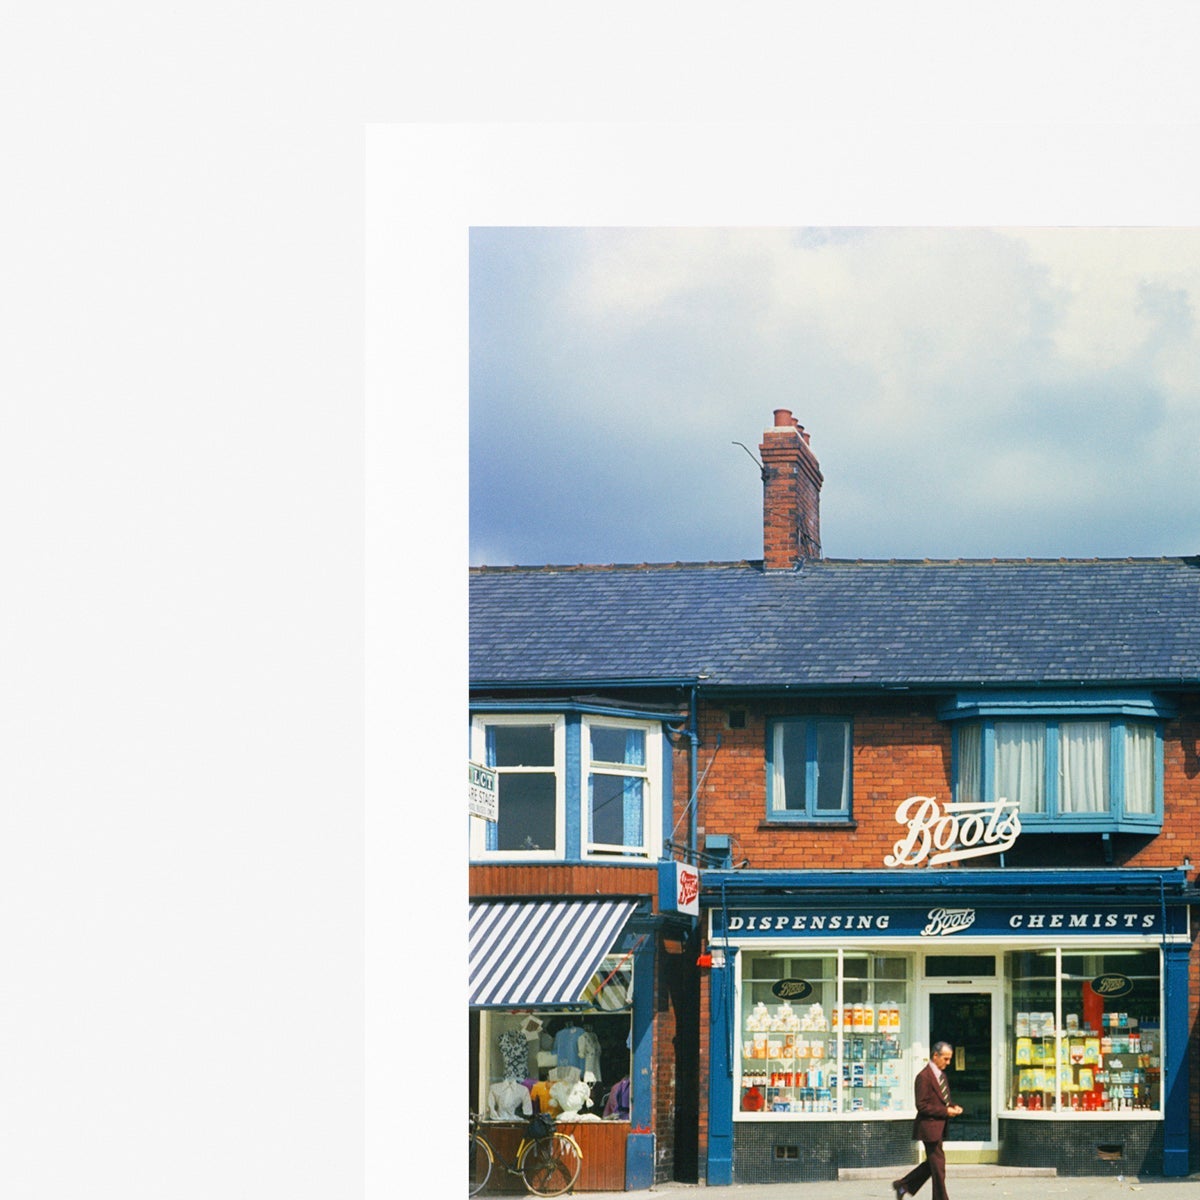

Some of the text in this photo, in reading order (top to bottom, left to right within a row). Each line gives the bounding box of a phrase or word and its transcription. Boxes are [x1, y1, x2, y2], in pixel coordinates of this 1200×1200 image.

[883, 796, 1022, 867] Boots
[678, 870, 698, 906] Boots
[728, 907, 1155, 936] DISPENSING Boots CHEMISTS
